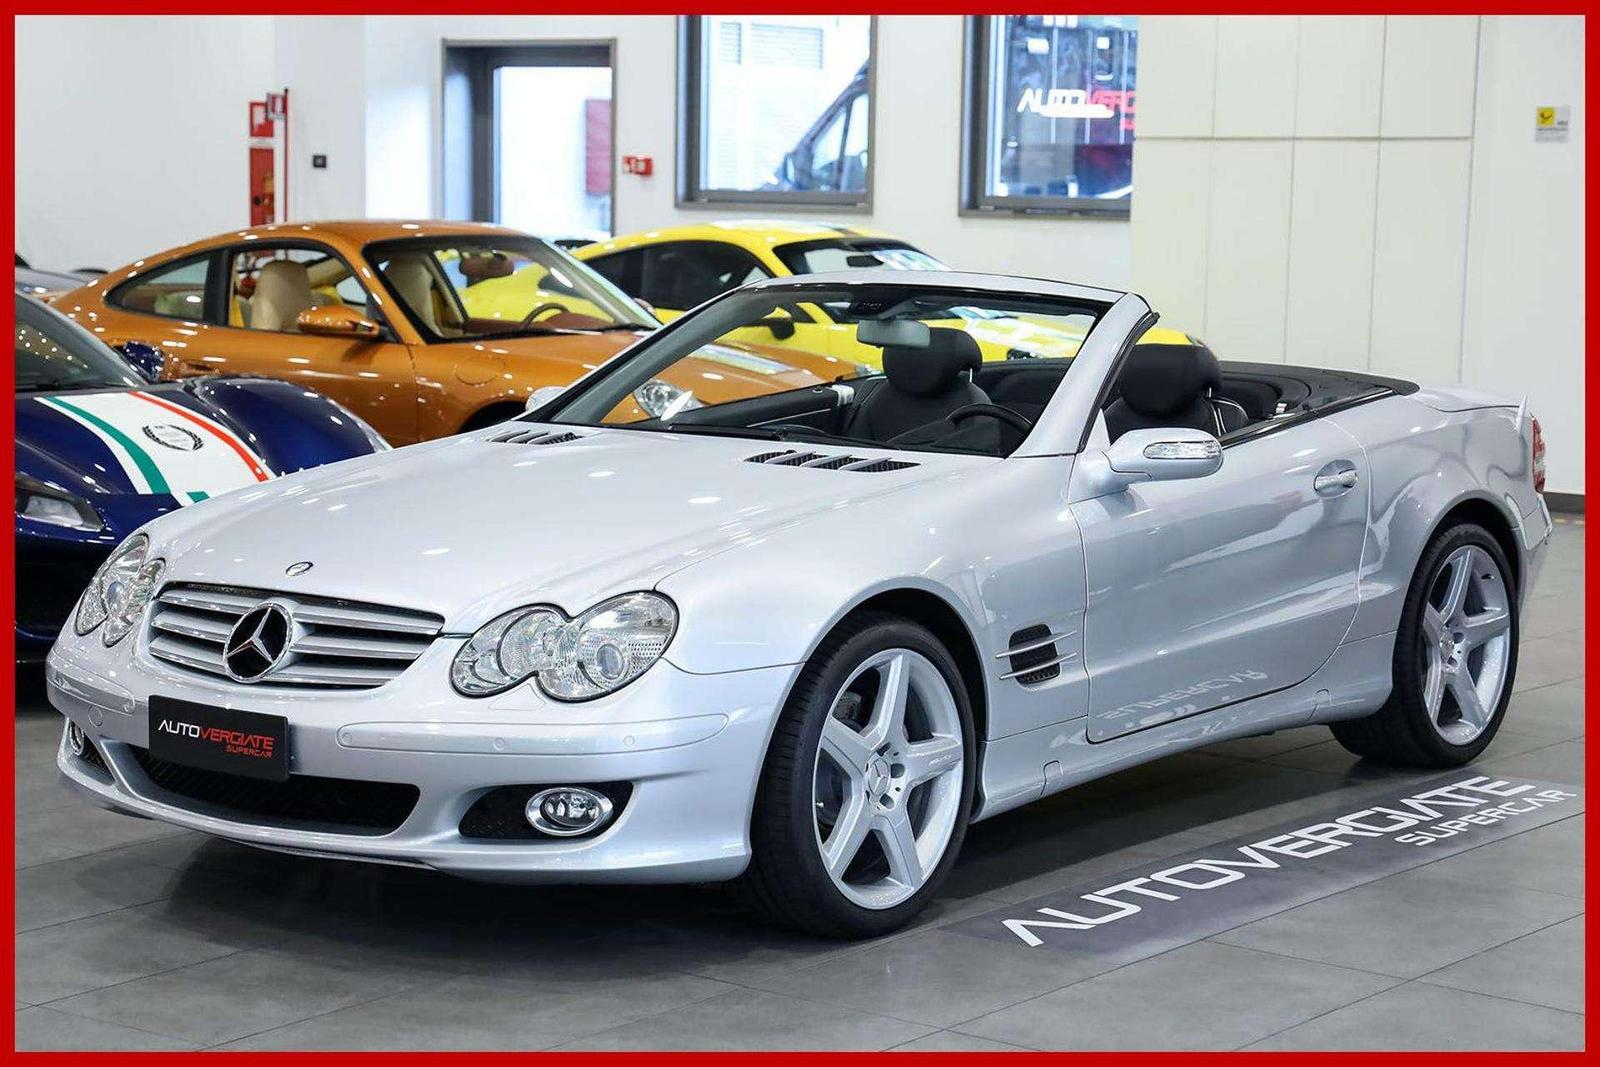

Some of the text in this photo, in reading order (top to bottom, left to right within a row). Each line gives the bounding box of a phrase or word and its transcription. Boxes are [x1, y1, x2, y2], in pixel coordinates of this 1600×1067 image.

[158, 719, 275, 750] AUTOVERGIATE
[226, 744, 273, 759] SUPERCAR
[1394, 788, 1577, 847] SUPERCAR
[1002, 776, 1536, 947] AUTOVERGIATE
